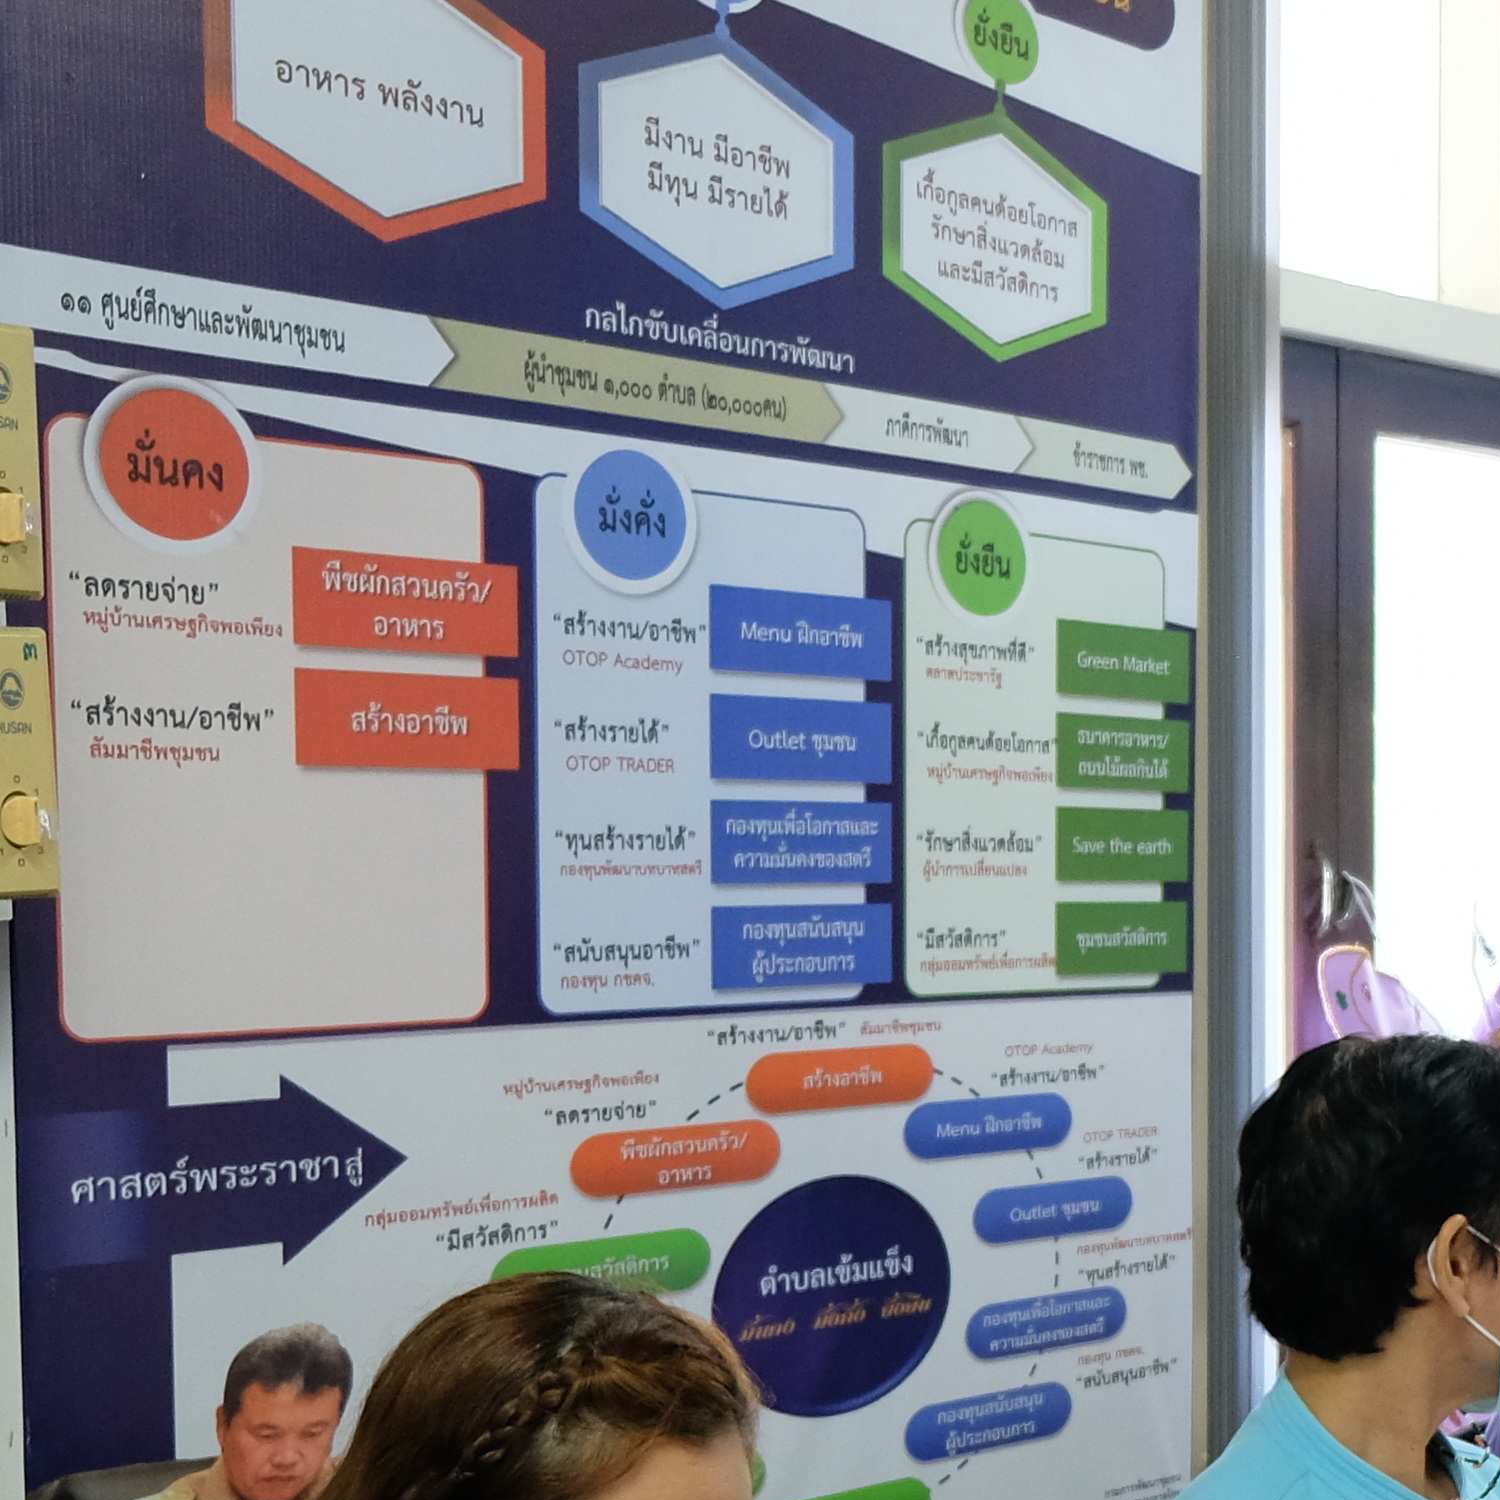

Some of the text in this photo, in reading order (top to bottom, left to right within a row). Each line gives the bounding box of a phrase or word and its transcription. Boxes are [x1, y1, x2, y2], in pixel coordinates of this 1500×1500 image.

[973, 7, 1030, 60] ยั่งยืน
[275, 57, 485, 129] อาหาร พลังงาน
[643, 117, 791, 179] มีงาน มีอาชีพ
[647, 164, 789, 222] มีทุน มีรายได้
[931, 215, 1066, 271] รักษาสิ่งแวดล้อม
[937, 256, 1059, 303] และมีสวัสดิการ
[60, 287, 346, 355] ๑๑ ศูนย์ศึกษาและพัฒนาชุมชน
[584, 302, 855, 375] กลไกขับเคลื่อนการพัฒนา
[522, 350, 599, 395] ผู้นำชุมชน
[658, 377, 696, 408] ตำบล
[126, 430, 224, 492] มั่นคง
[598, 490, 667, 539] มั่งคั่ง
[954, 534, 1012, 581] ยั่งยืน
[321, 563, 493, 605] พืชผักสวนครัว/
[82, 608, 284, 640] หมู่บ้านเศรษฐกิจพอเพียง
[373, 613, 445, 640] อาหาร
[741, 620, 864, 649] Menu ฝึกอาชีพ
[562, 650, 683, 676] OTOP Academy
[1077, 651, 1171, 676] Green Market
[351, 705, 469, 738] สร้างอาชีพ
[89, 738, 220, 768] สัมมาชีพชุมชน
[749, 729, 858, 758] Outlet ชุมชน
[566, 755, 675, 775] OTOP TRADER
[726, 809, 879, 842] กองทุนเพื่อโอกาสและ
[734, 842, 873, 870] ความมั่นคงของสตรี
[1072, 835, 1172, 855] Save the earth
[742, 915, 866, 947] กองทุนสนับสนุน
[752, 951, 856, 984] ผู้ประกอบการ
[560, 974, 609, 994] กองทุน
[1004, 1041, 1094, 1058] OTOP Academy
[803, 1063, 884, 1090] สร้างอาชีพ
[620, 1129, 748, 1161] พืชผักสวนครัว/
[936, 1122, 981, 1139] Menu
[1083, 1125, 1158, 1143] OTOP TRADER
[658, 1165, 713, 1185] อาหาร
[1009, 1204, 1057, 1224] Outlet
[760, 1244, 913, 1296] ตำบลเข้มแข็ง
